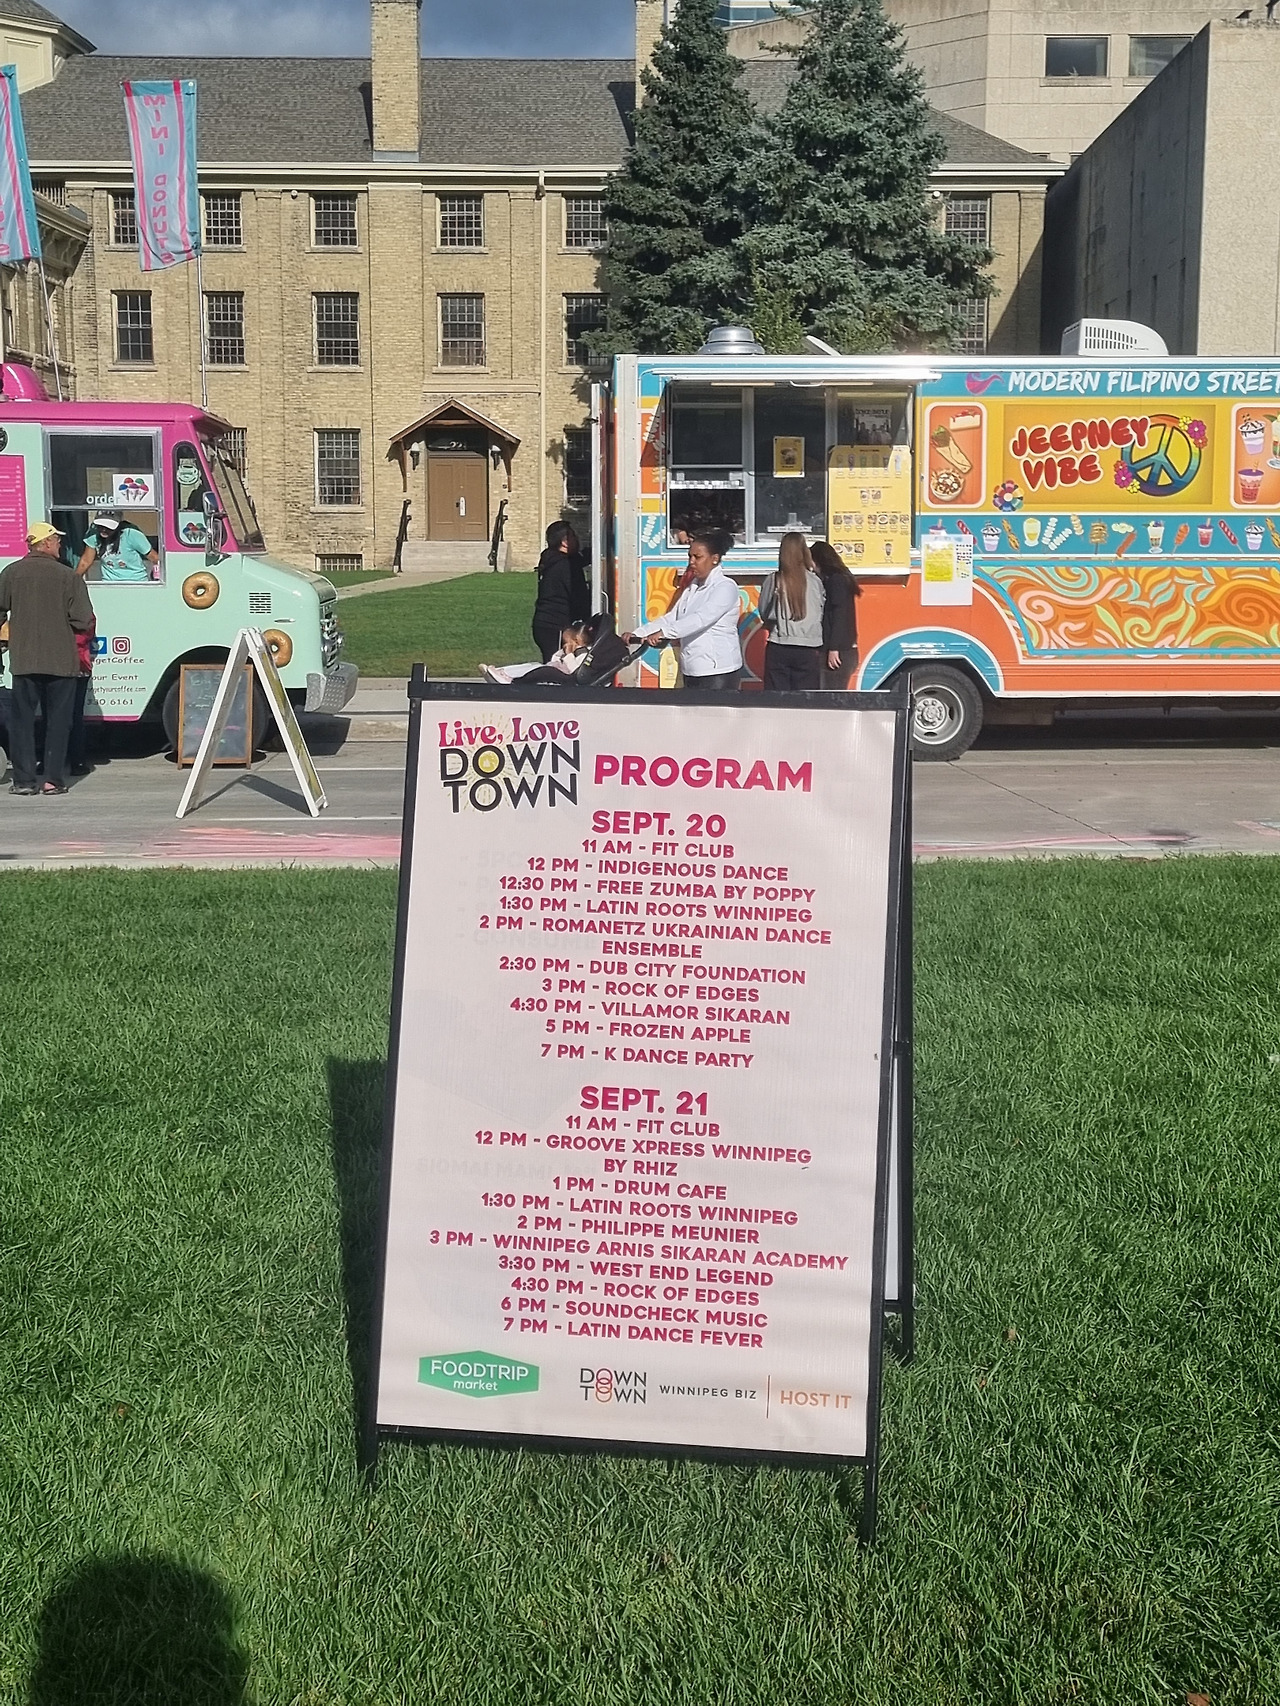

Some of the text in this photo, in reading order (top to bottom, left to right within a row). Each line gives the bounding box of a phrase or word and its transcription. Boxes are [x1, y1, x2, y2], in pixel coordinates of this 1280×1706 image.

[1008, 370, 1102, 393] MODERN
[1106, 370, 1201, 394] FILIPINO
[1011, 416, 1151, 457] JEEPNEY
[1022, 454, 1102, 491] VIBE
[92, 657, 145, 666] getCoffee
[92, 674, 108, 682] our
[110, 698, 134, 706] 6161
[438, 717, 580, 747] Live, Love
[440, 739, 581, 782] DOWN
[594, 754, 813, 793] PROGRAM
[442, 772, 578, 814] TOWN
[591, 810, 727, 839] SEPT. 20
[582, 839, 597, 853] 11
[602, 839, 632, 854] AM
[651, 841, 679, 857] FIT
[683, 843, 734, 859] CLUB
[527, 857, 545, 871] 12
[550, 857, 579, 873] PM
[597, 860, 716, 879] INDIGENOUS
[722, 864, 787, 882] DANCE
[499, 875, 544, 891] 12:30
[550, 878, 578, 892] PM
[596, 879, 643, 895] FREE
[650, 882, 717, 899] ZUMBA
[722, 885, 747, 899] BY
[752, 886, 815, 903] POPPY
[499, 895, 534, 911] 1:30
[539, 897, 567, 912] PM
[586, 900, 639, 915] LATIN
[644, 902, 707, 919] ROOTS
[712, 905, 813, 923] WINNIPEG
[479, 915, 490, 929] 2
[495, 915, 523, 930] PM
[542, 917, 646, 936] ROMANETZ
[651, 923, 759, 941] UKRAINIAN
[764, 927, 831, 945] DANCE
[601, 940, 702, 959] ENSEMBLE
[499, 956, 537, 971] 2:30
[542, 957, 570, 972] PM
[589, 960, 628, 976] DUB
[633, 962, 675, 977] CITY
[681, 964, 806, 985] FOUNDATION
[542, 978, 553, 993] 3
[557, 978, 586, 993] PM
[604, 980, 656, 997] ROCK
[662, 984, 689, 999] OF
[694, 985, 760, 1003] EDGES
[510, 997, 548, 1012] 4:30
[553, 998, 582, 1014] PM
[600, 1002, 699, 1020] VILLAMOR
[704, 1006, 790, 1025] SIKARAN
[545, 1018, 556, 1033] 5
[561, 1019, 590, 1034] PM
[608, 1021, 685, 1040] FROZEN
[690, 1026, 750, 1044] APPLE
[542, 1043, 551, 1057] 7
[556, 1044, 585, 1058] PM
[603, 1047, 615, 1061] K
[622, 1047, 688, 1065] DANCE
[694, 1051, 752, 1068] PARTY
[581, 1085, 708, 1116] SEPT. 21
[566, 1116, 581, 1129] 11
[586, 1116, 617, 1131] AM
[635, 1119, 663, 1133] FIT
[668, 1121, 720, 1137] CLUB
[475, 1130, 493, 1145] 12
[499, 1131, 527, 1146] PM
[545, 1134, 625, 1153] GROOVE
[633, 1140, 705, 1157] XPRESS
[711, 1144, 811, 1163] WINNIPEG
[603, 1158, 626, 1173] BY
[632, 1160, 677, 1177] RHIZ
[553, 1176, 561, 1189] 1
[565, 1176, 594, 1191] PM
[613, 1179, 670, 1196] DRUM
[676, 1183, 726, 1200] CAFE
[481, 1193, 516, 1208] 1:30
[521, 1194, 550, 1209] PM
[569, 1199, 623, 1215] LATIN
[628, 1201, 691, 1219] ROOTS
[698, 1206, 798, 1225] WINNIPEG
[517, 1215, 528, 1229] 2
[533, 1215, 562, 1231] PM
[580, 1218, 664, 1238] PHILIPPE
[670, 1224, 759, 1244] MEUNIER
[430, 1230, 440, 1244] 3
[445, 1231, 473, 1245] PM
[493, 1234, 590, 1254] WINNIPEG
[596, 1241, 655, 1258] ARNIS
[660, 1244, 746, 1264] SIKARAN
[752, 1250, 847, 1269] ACADEMY
[500, 1254, 536, 1271] 3:30
[541, 1257, 570, 1273] PM
[589, 1261, 643, 1278] WEST
[648, 1264, 689, 1281] END
[694, 1268, 774, 1287] LEGEND
[510, 1277, 550, 1293] 4:30
[555, 1279, 584, 1294] PM
[602, 1282, 656, 1299] ROCK
[662, 1286, 688, 1301] OF
[694, 1288, 760, 1306] EDGES
[500, 1297, 512, 1311] 6
[517, 1297, 546, 1312] PM
[564, 1300, 697, 1323] SOUNDCHECK
[704, 1309, 766, 1328] MUSIC
[505, 1317, 514, 1330] 7
[519, 1317, 548, 1333] PM
[567, 1321, 621, 1339] LATIN
[627, 1325, 693, 1343] DANCE
[699, 1329, 763, 1348] FEVER
[430, 1359, 529, 1382] FOODTRIP
[580, 1367, 648, 1388] DOWN
[453, 1378, 498, 1392] market
[580, 1384, 647, 1404] TOWN
[659, 1384, 757, 1400] WINNIPEG BIZ
[780, 1390, 852, 1410] HOST IT
